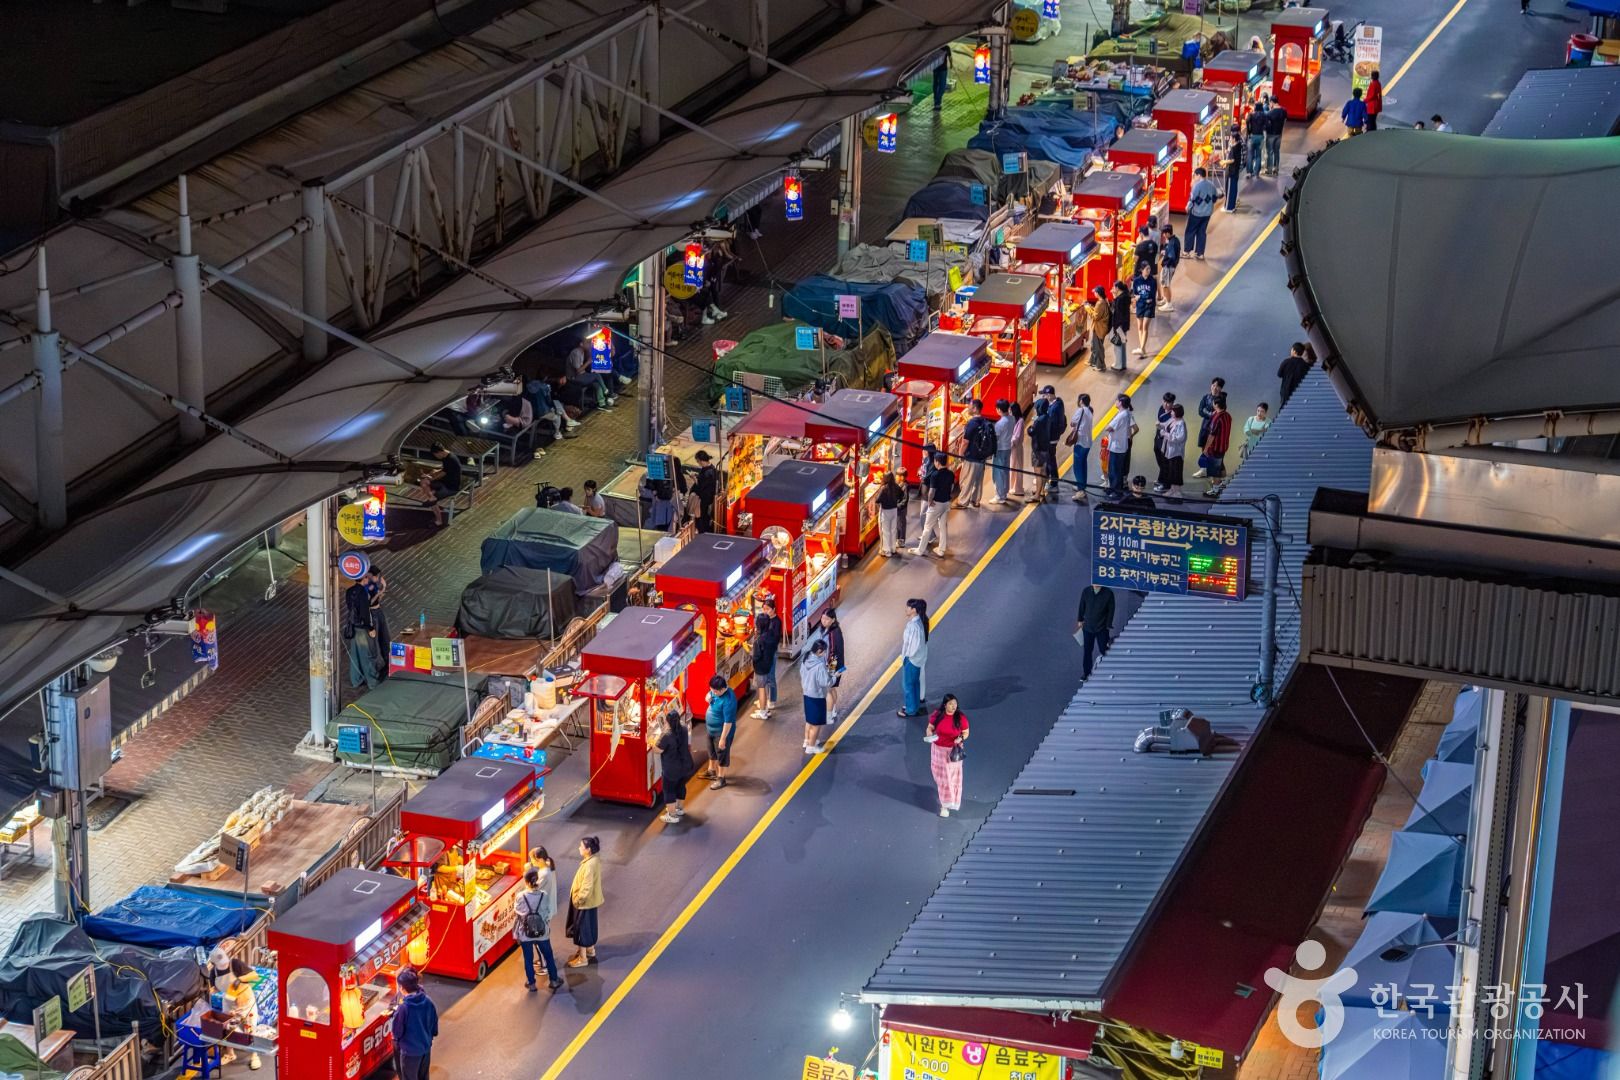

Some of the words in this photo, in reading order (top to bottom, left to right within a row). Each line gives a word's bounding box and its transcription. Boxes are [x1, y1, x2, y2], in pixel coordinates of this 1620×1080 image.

[1099, 515, 1239, 546] 2지구종합상가주차장
[1100, 533, 1115, 546] 전방
[1118, 535, 1138, 549] 110m
[1099, 547, 1116, 559] B2
[1098, 566, 1115, 578] B3
[904, 1032, 954, 1058] 시원한
[966, 1046, 982, 1063] 냉
[995, 1047, 1047, 1068] 음료수
